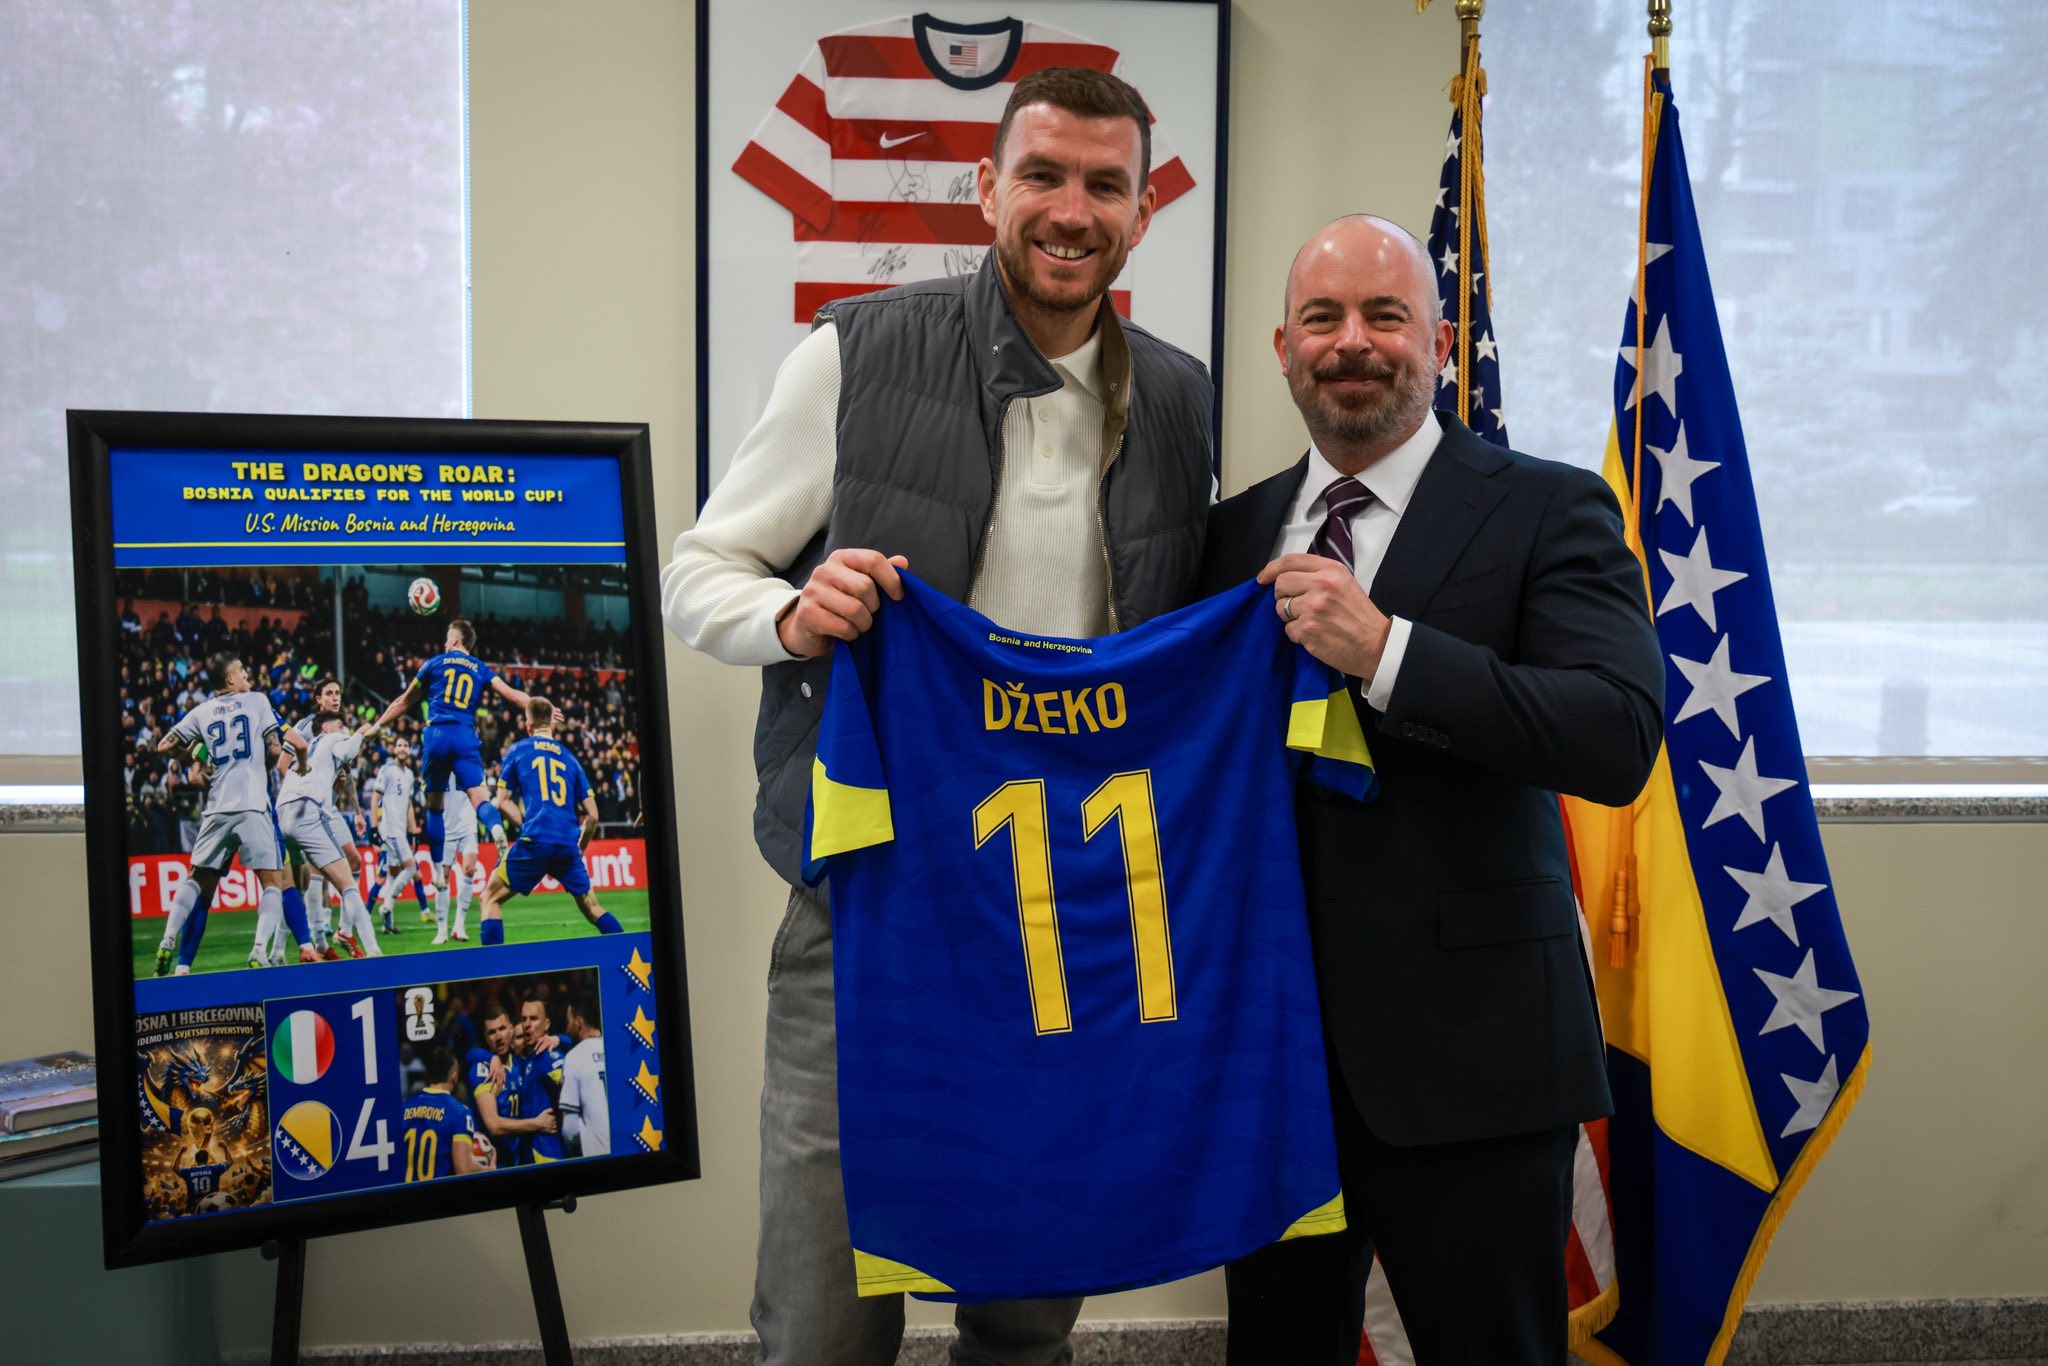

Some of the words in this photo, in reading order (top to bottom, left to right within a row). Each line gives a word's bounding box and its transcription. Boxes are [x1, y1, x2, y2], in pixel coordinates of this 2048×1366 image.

[231, 461, 285, 481] THE
[302, 463, 424, 483] DRAGON'S
[438, 465, 516, 483] ROAR:
[182, 487, 254, 500] BOSNIA
[264, 488, 366, 501] QUALIFIES
[376, 489, 410, 501] FOR
[419, 489, 452, 501] THE
[461, 490, 515, 502] WORLD
[524, 490, 563, 502] CUP!
[245, 512, 276, 533] U.S.
[280, 513, 340, 533] Mission
[344, 513, 396, 534] Bosnia
[399, 514, 429, 532] and
[431, 513, 516, 537] Herzegovina
[989, 632, 1021, 646] Bosnia
[1023, 639, 1041, 649] and
[1042, 640, 1093, 655] Herzegovina
[443, 667, 474, 709] 10
[982, 677, 1127, 735] DŽEKO
[207, 714, 252, 766] 23
[531, 755, 567, 807] 15
[972, 768, 1178, 1036] 11
[171, 1012, 177, 1027] I
[179, 1006, 264, 1025] HERCEGOVINA
[163, 1032, 174, 1042] NA
[175, 1028, 210, 1040] SVJETSKO
[211, 1025, 254, 1036] PRVENSTVO!
[351, 996, 378, 1085] 1
[508, 1093, 519, 1117] 11
[345, 1097, 395, 1172] 4
[404, 1128, 438, 1184] 10
[192, 1176, 211, 1194] 10
